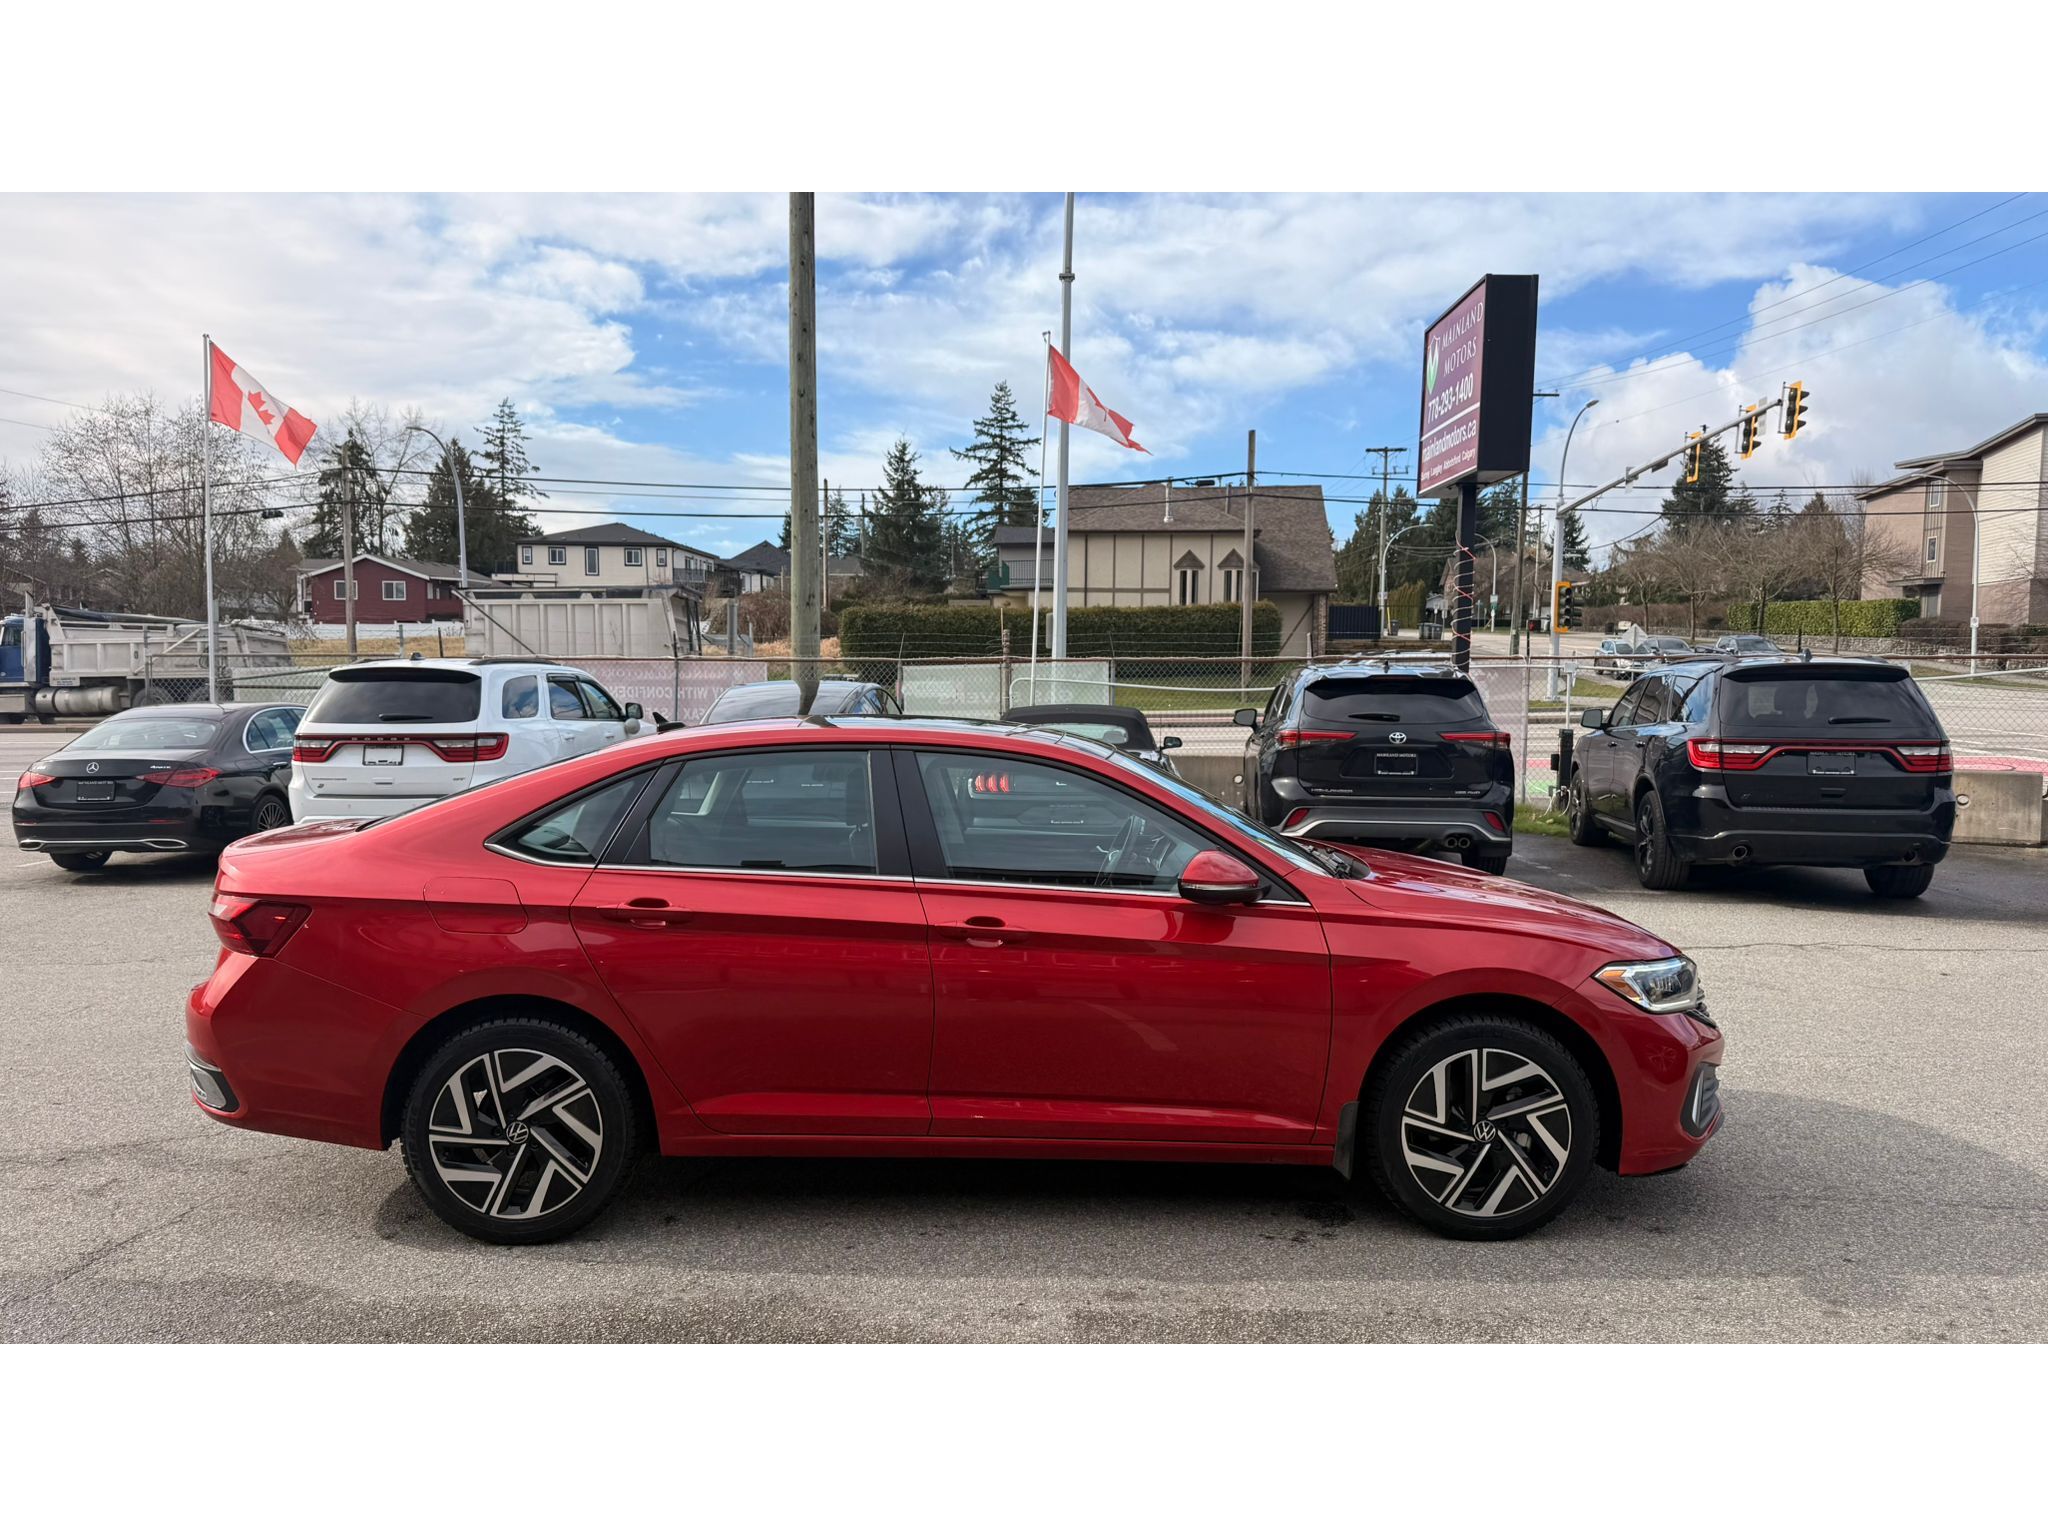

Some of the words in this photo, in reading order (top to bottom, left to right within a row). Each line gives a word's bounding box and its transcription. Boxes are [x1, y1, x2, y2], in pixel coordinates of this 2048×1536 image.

[1442, 302, 1484, 351] MAINLAND
[1443, 335, 1477, 377] MOTORS
[1427, 372, 1474, 425] 778-293-1400
